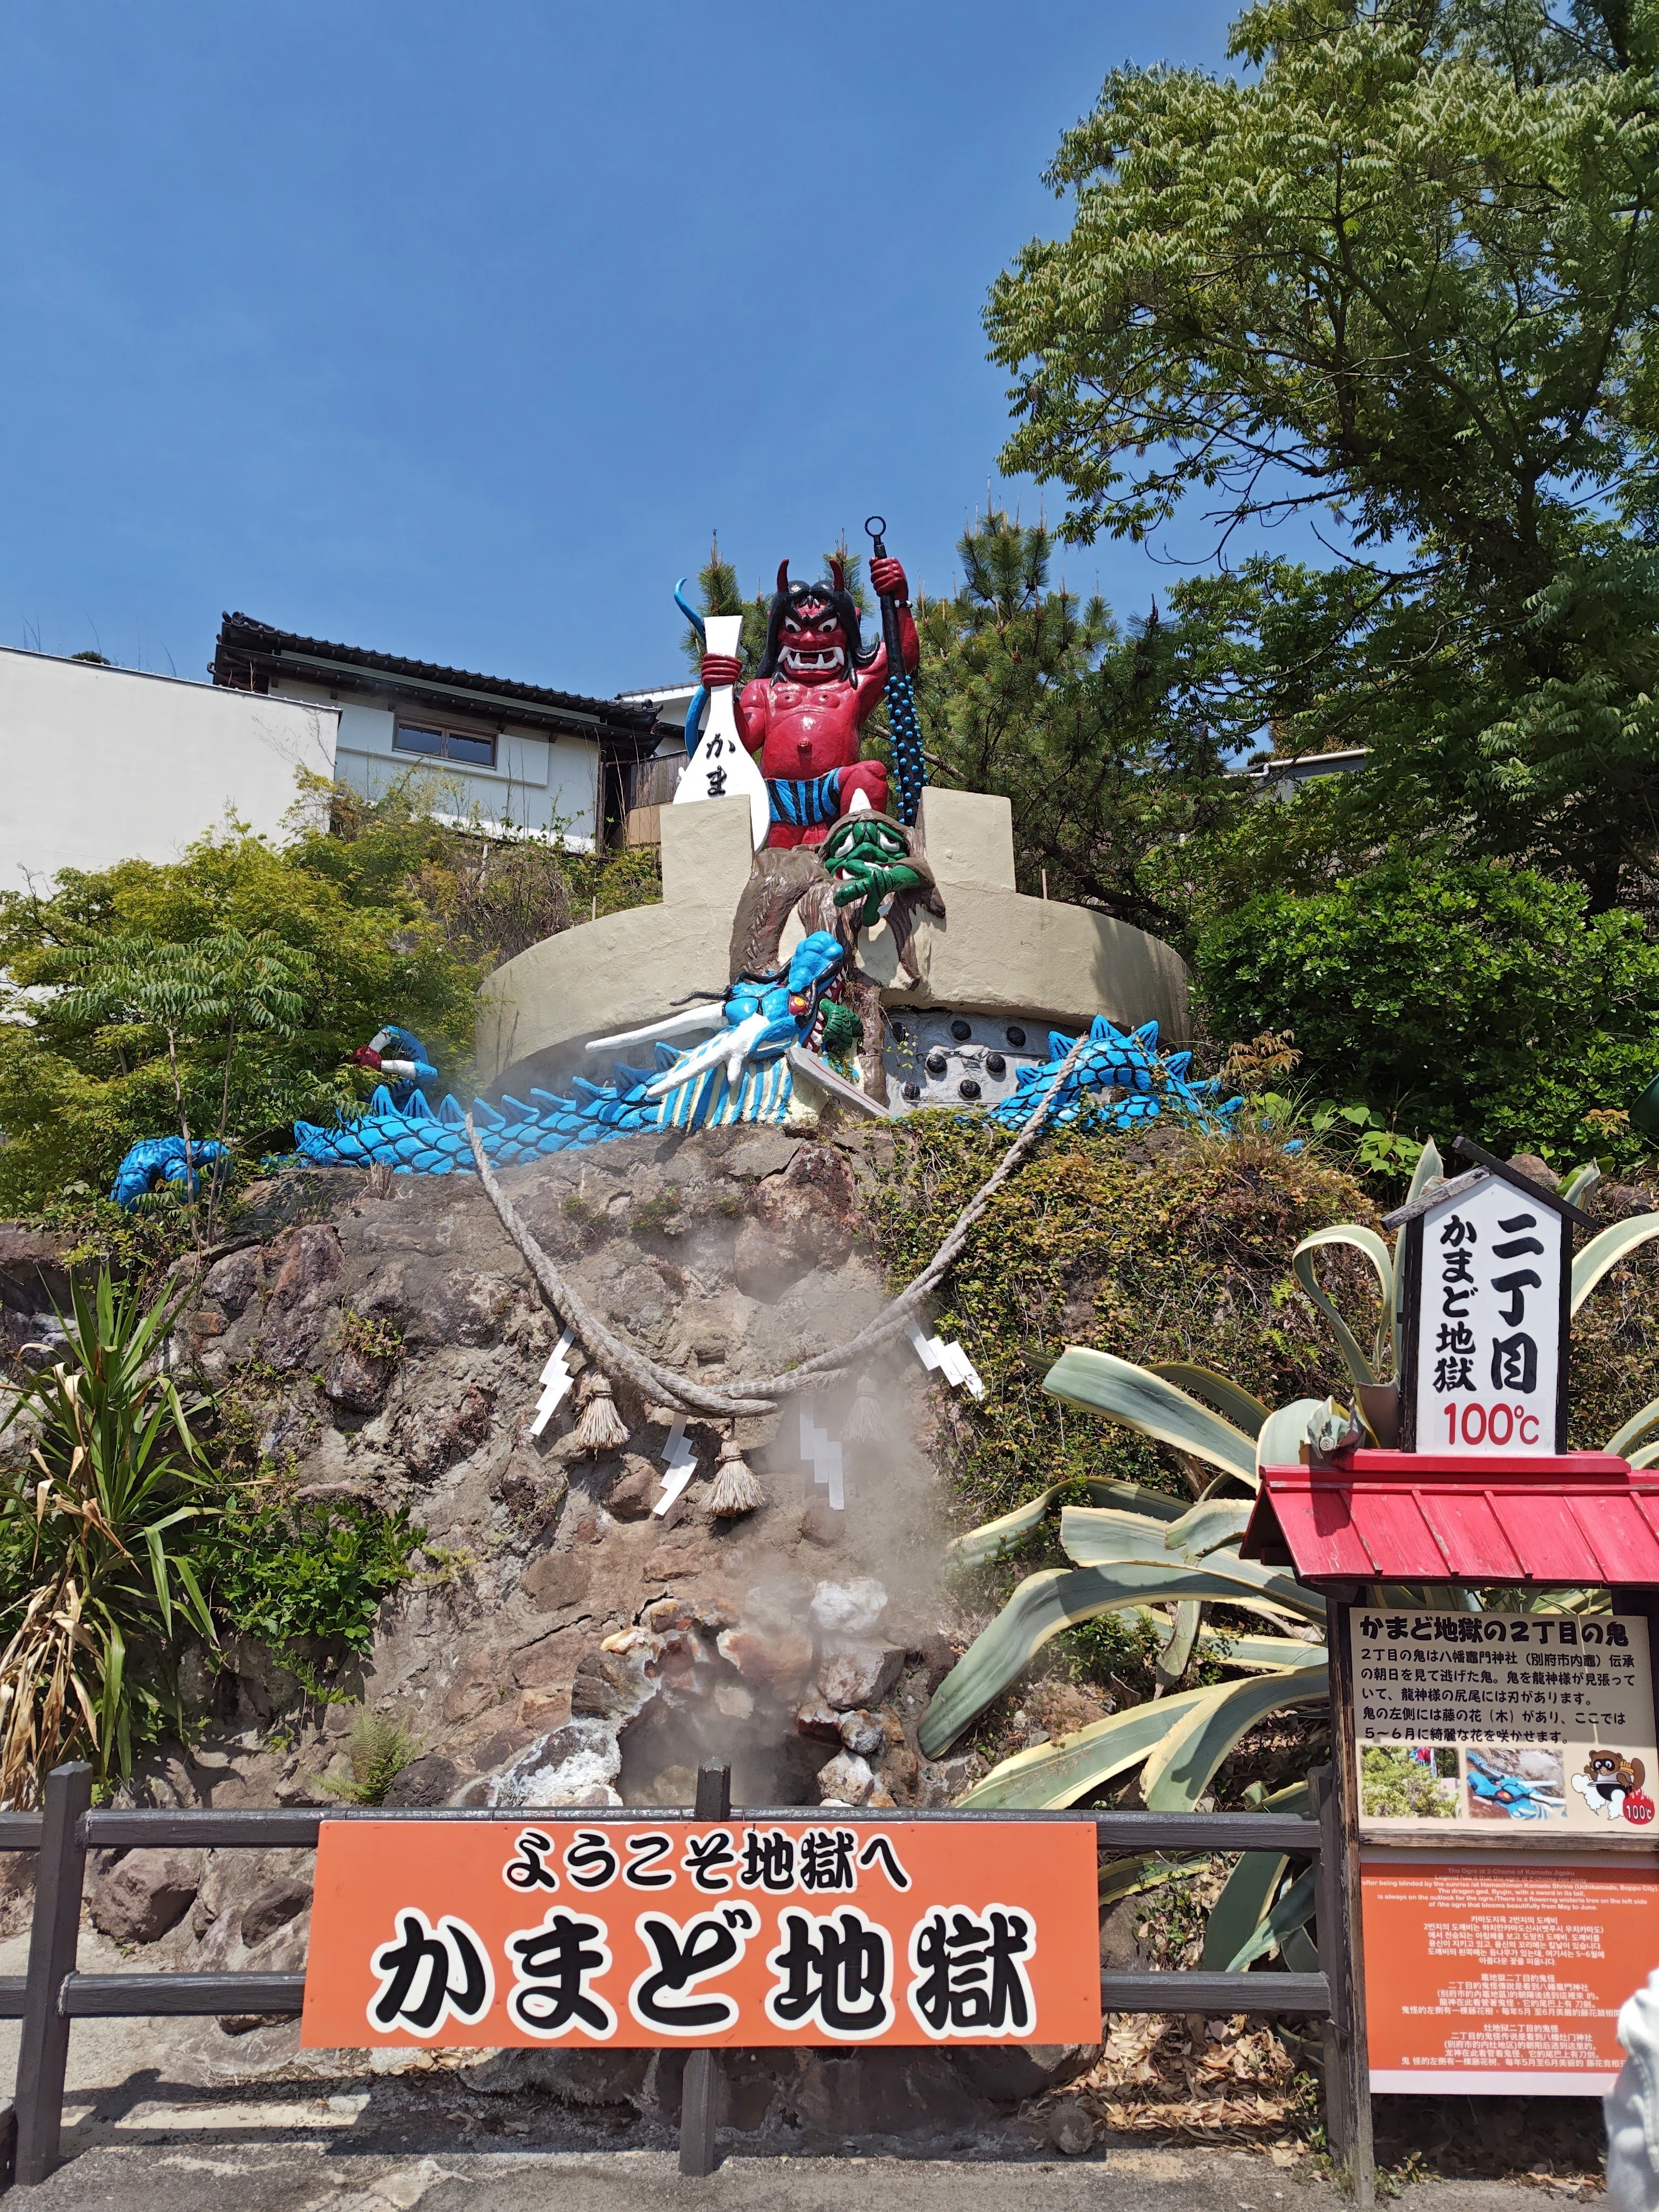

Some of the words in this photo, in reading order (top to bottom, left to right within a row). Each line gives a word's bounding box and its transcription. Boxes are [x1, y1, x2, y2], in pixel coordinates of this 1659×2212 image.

[1432, 1215, 1479, 1393] かまど地獄
[1491, 1213, 1544, 1394] 二丁目
[505, 1830, 908, 1890] ようこそ地獄へ
[374, 1909, 1029, 2031] かまど地獄
